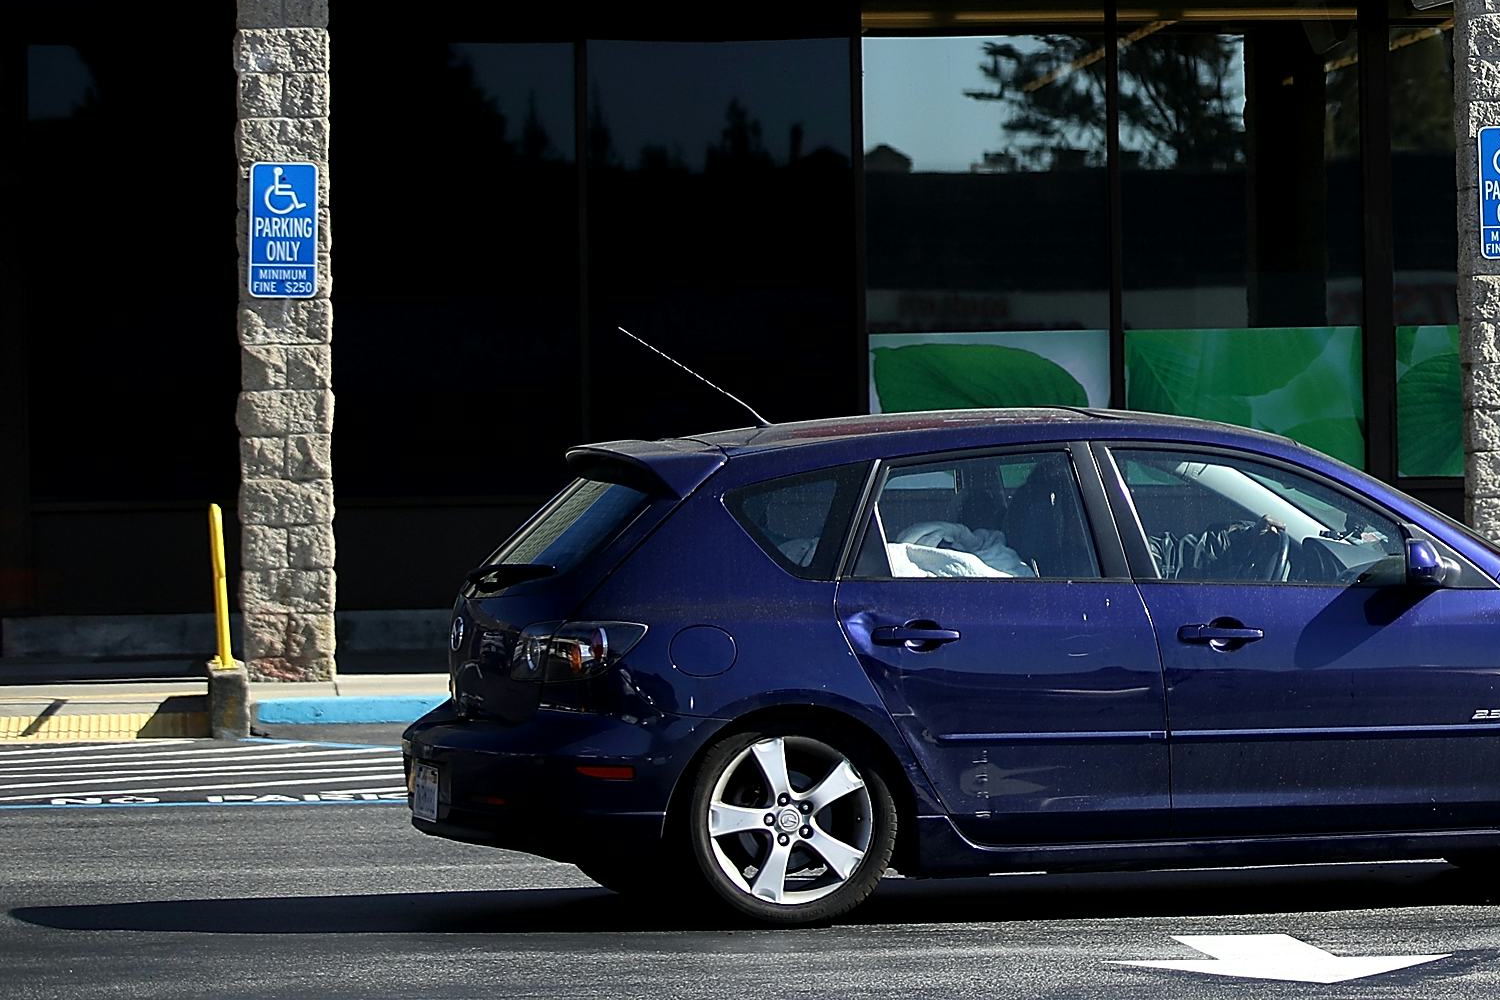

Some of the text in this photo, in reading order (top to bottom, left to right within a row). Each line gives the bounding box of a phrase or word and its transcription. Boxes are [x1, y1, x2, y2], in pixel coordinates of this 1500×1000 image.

[255, 217, 313, 238] PARKING
[266, 241, 301, 262] ONLY
[259, 269, 307, 281] MINIMUM
[253, 282, 277, 293] FINE
[51, 796, 160, 804] NO
